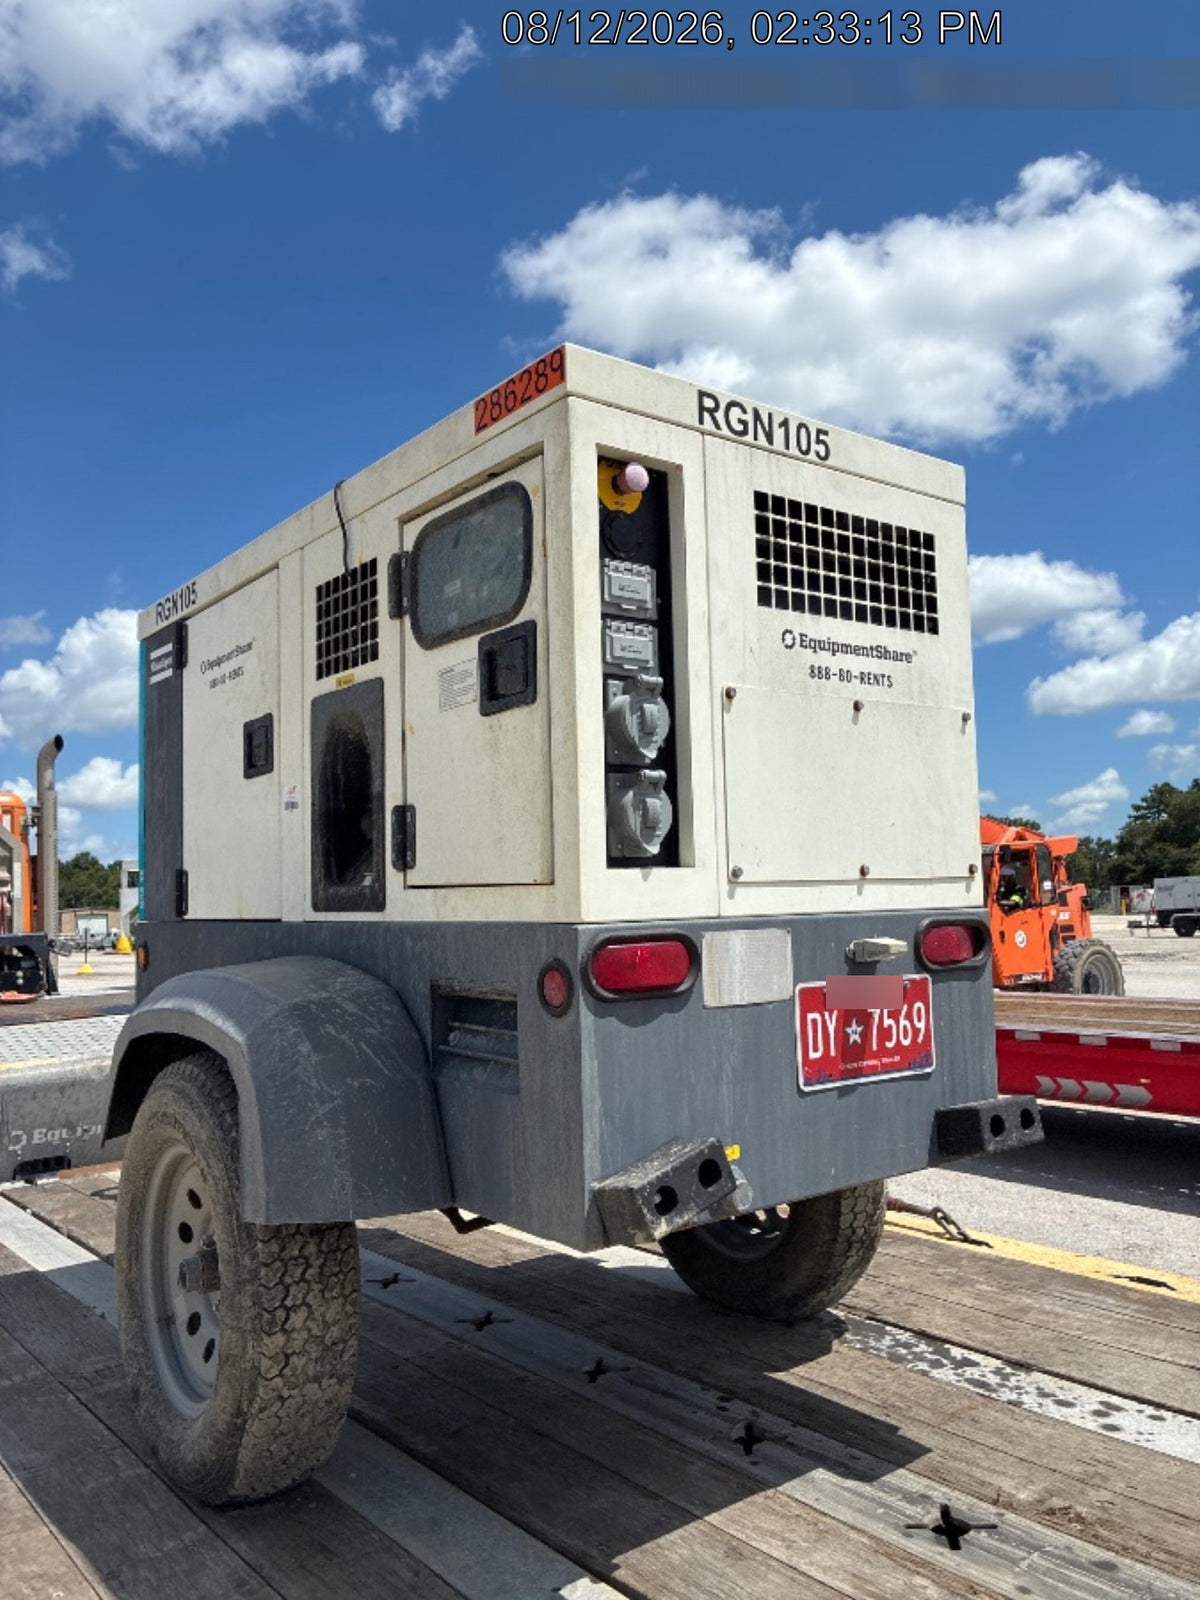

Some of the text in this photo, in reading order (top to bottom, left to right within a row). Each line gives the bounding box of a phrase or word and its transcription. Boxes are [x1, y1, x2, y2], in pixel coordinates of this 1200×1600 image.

[475, 349, 563, 433] 286289
[698, 389, 831, 461] RGN105
[155, 581, 198, 626] RGN105
[799, 632, 913, 664] EquipmentShare
[808, 664, 894, 688] 888-80-RENTS
[806, 1001, 926, 1060] DY 7569
